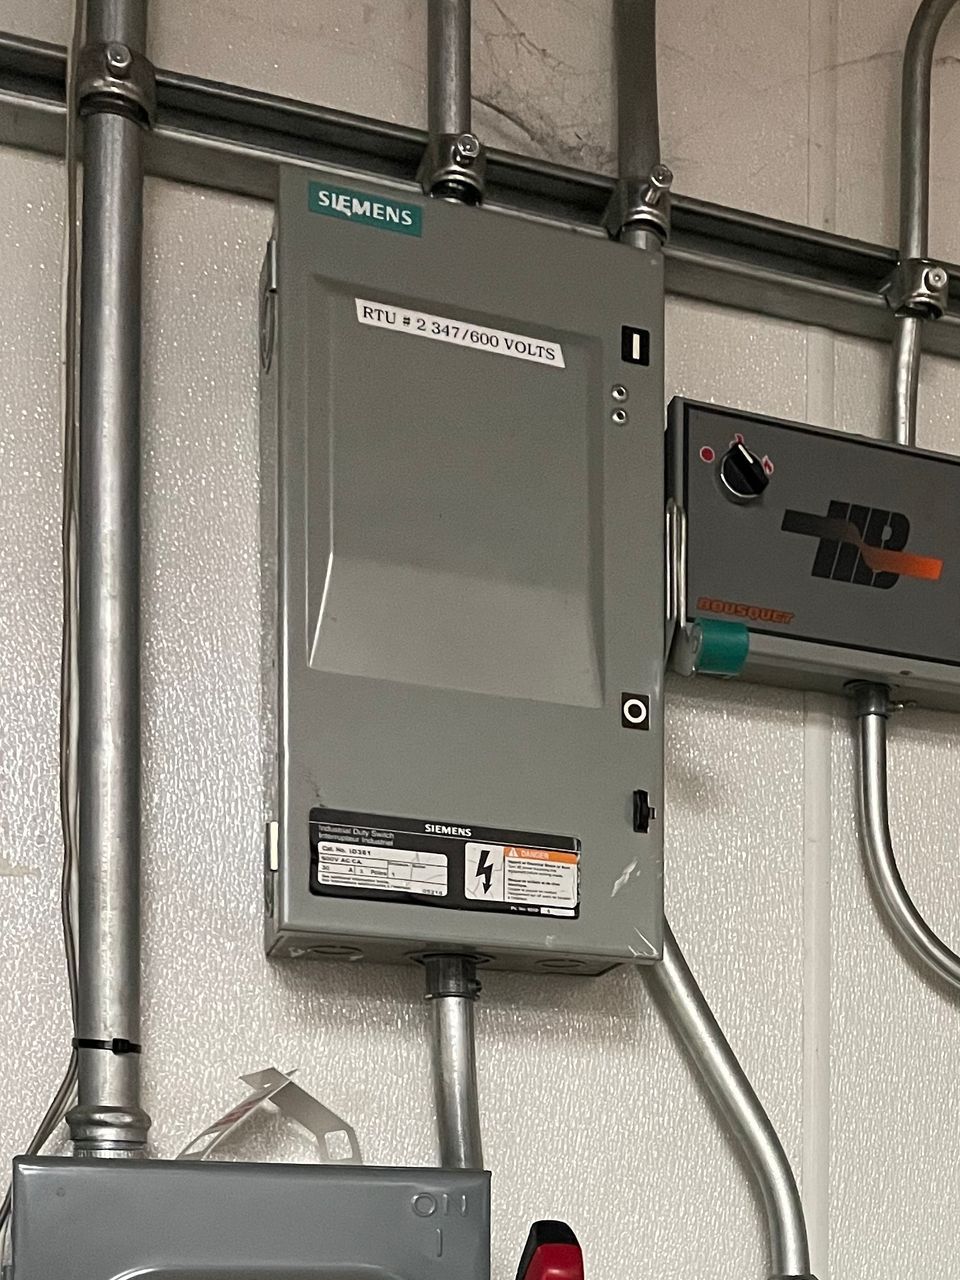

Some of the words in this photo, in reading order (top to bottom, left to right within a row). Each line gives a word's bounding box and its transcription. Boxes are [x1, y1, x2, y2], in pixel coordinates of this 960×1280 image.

[318, 189, 412, 226] SIEMENS
[362, 305, 397, 325] RTU
[401, 316, 412, 327] #
[416, 318, 426, 332] 2
[431, 321, 500, 349] 347/600
[504, 337, 556, 362] VOLTS
[697, 597, 795, 625] BOUSQUET
[424, 823, 472, 838] SIEMENS
